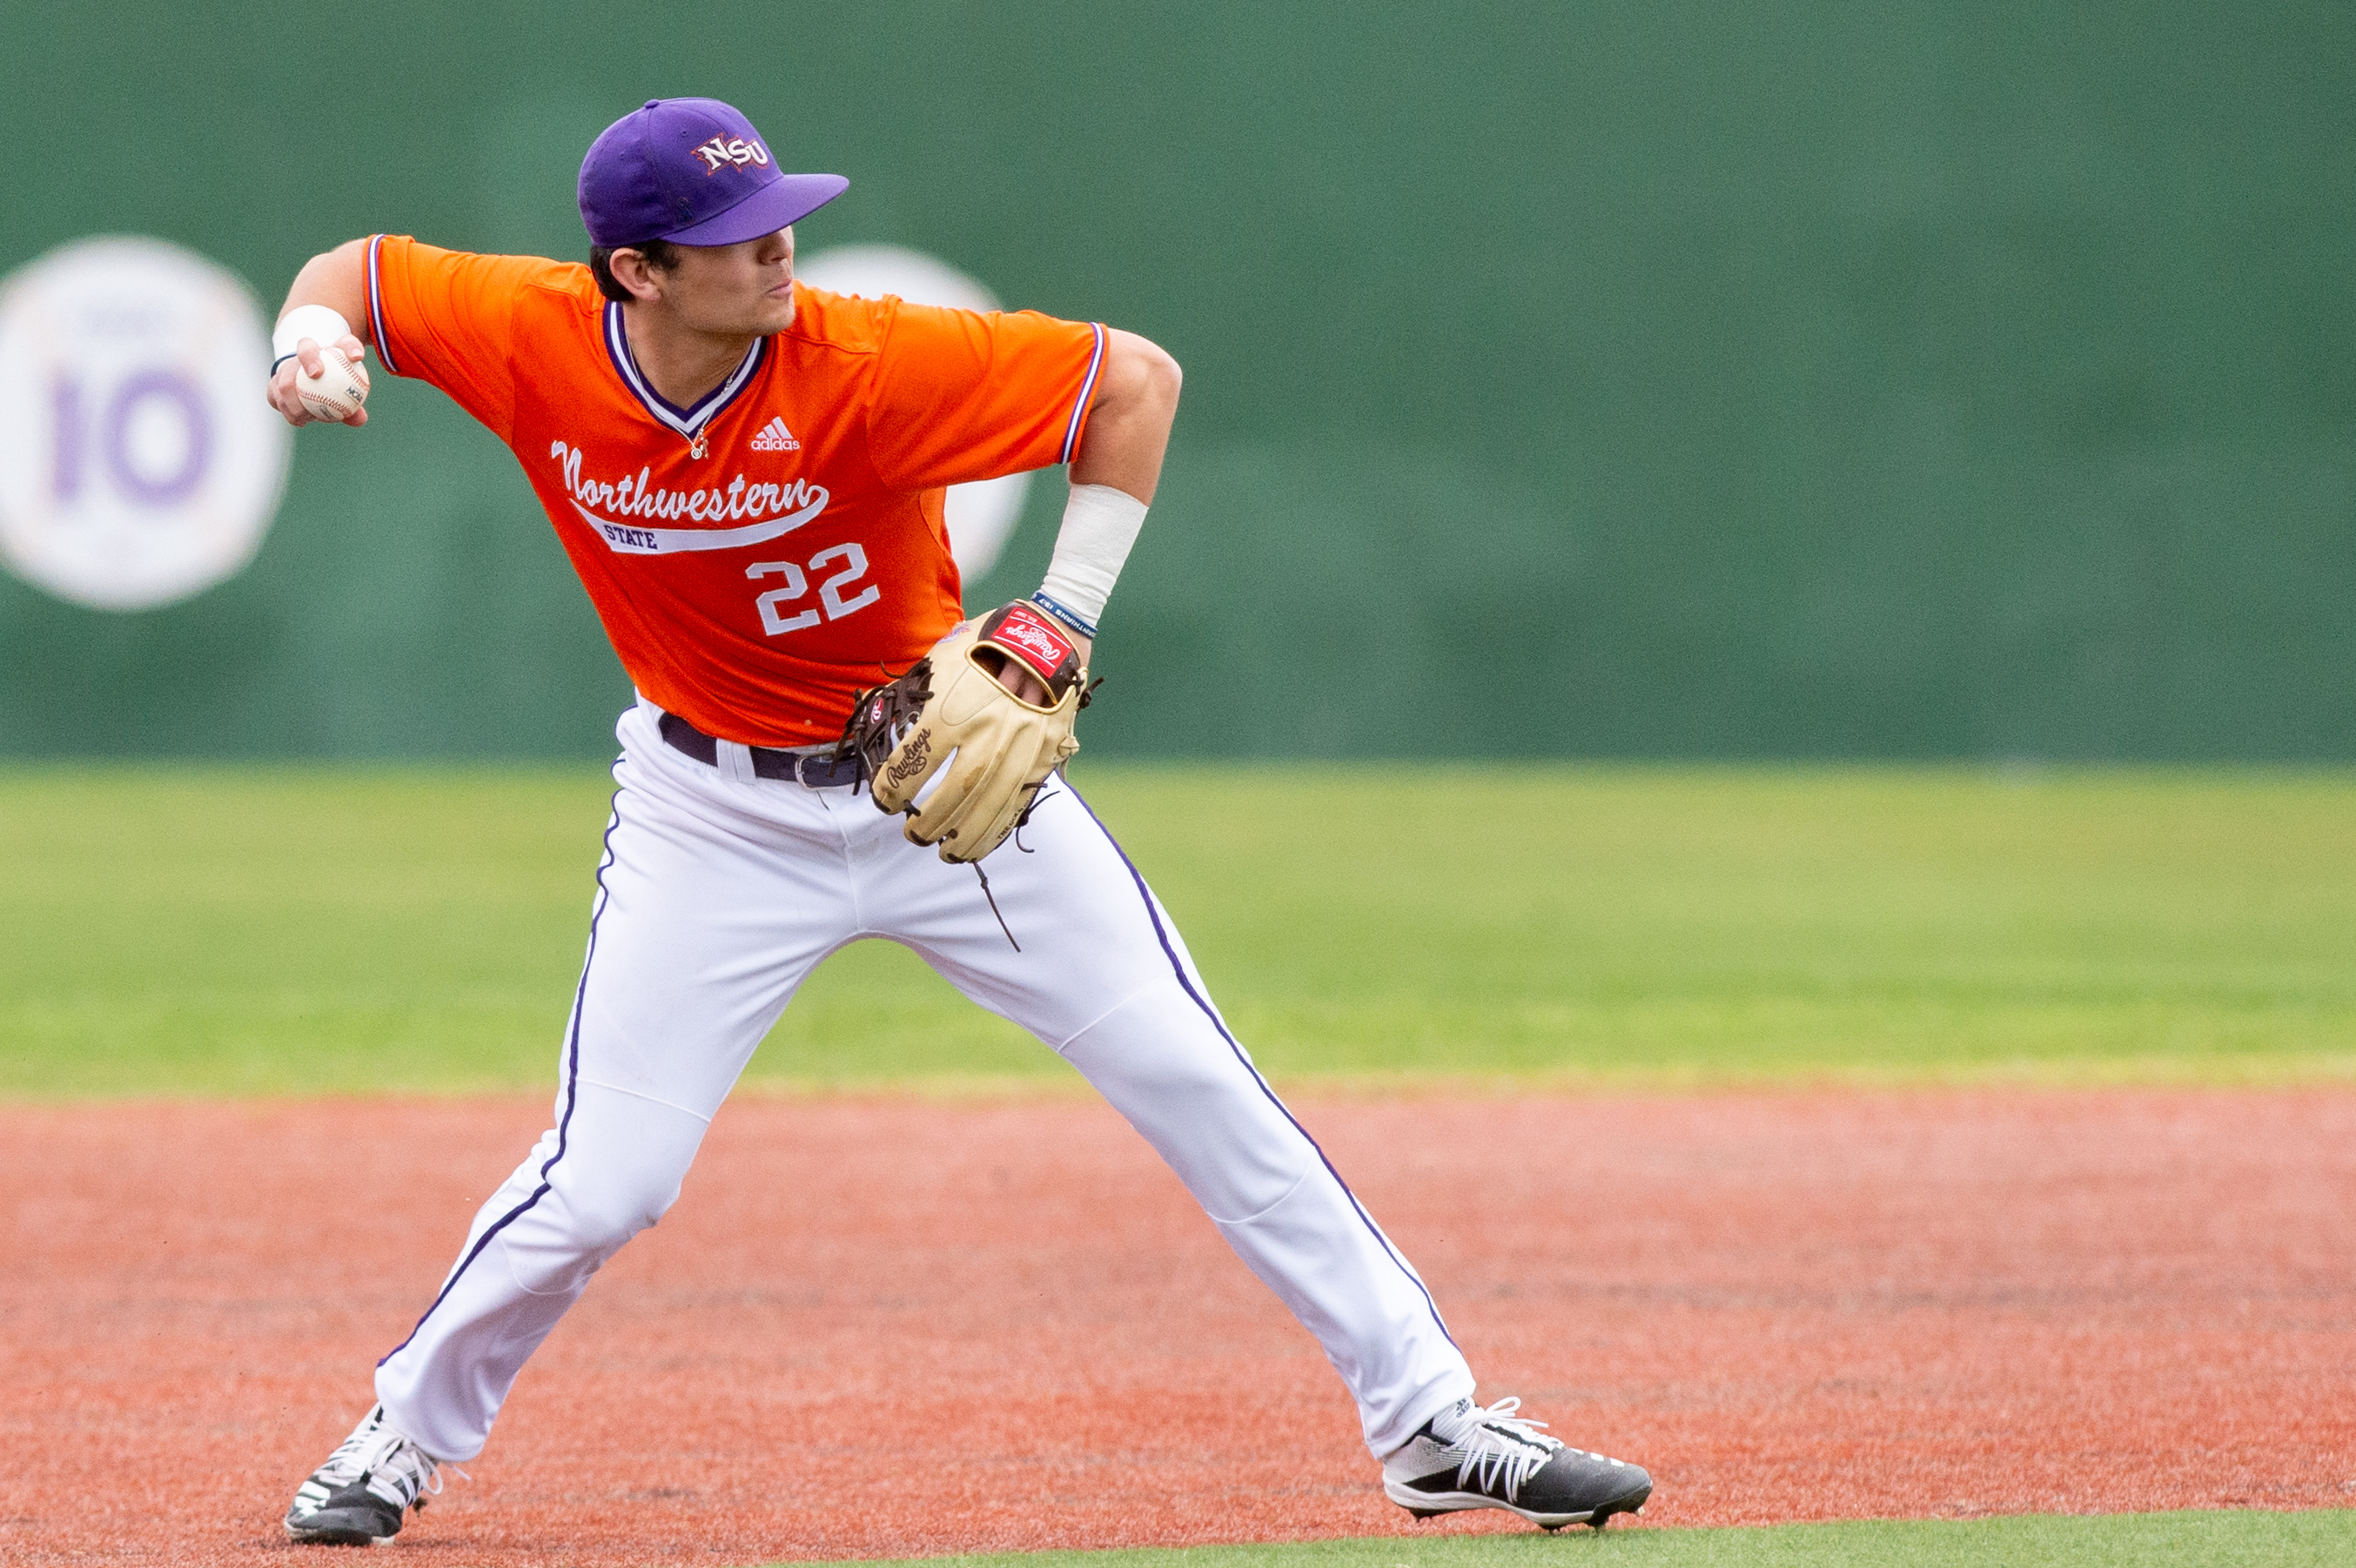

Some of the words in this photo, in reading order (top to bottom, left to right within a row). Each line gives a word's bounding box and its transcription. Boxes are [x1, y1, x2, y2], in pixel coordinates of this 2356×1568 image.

[698, 137, 769, 171] NSU
[52, 368, 214, 511] 10
[751, 439, 800, 451] adidas
[551, 440, 816, 522] Northwestern
[604, 524, 658, 550] STATE
[745, 543, 881, 636] 22
[1005, 624, 1060, 660] Rawlings
[887, 728, 931, 788] Rawlings
